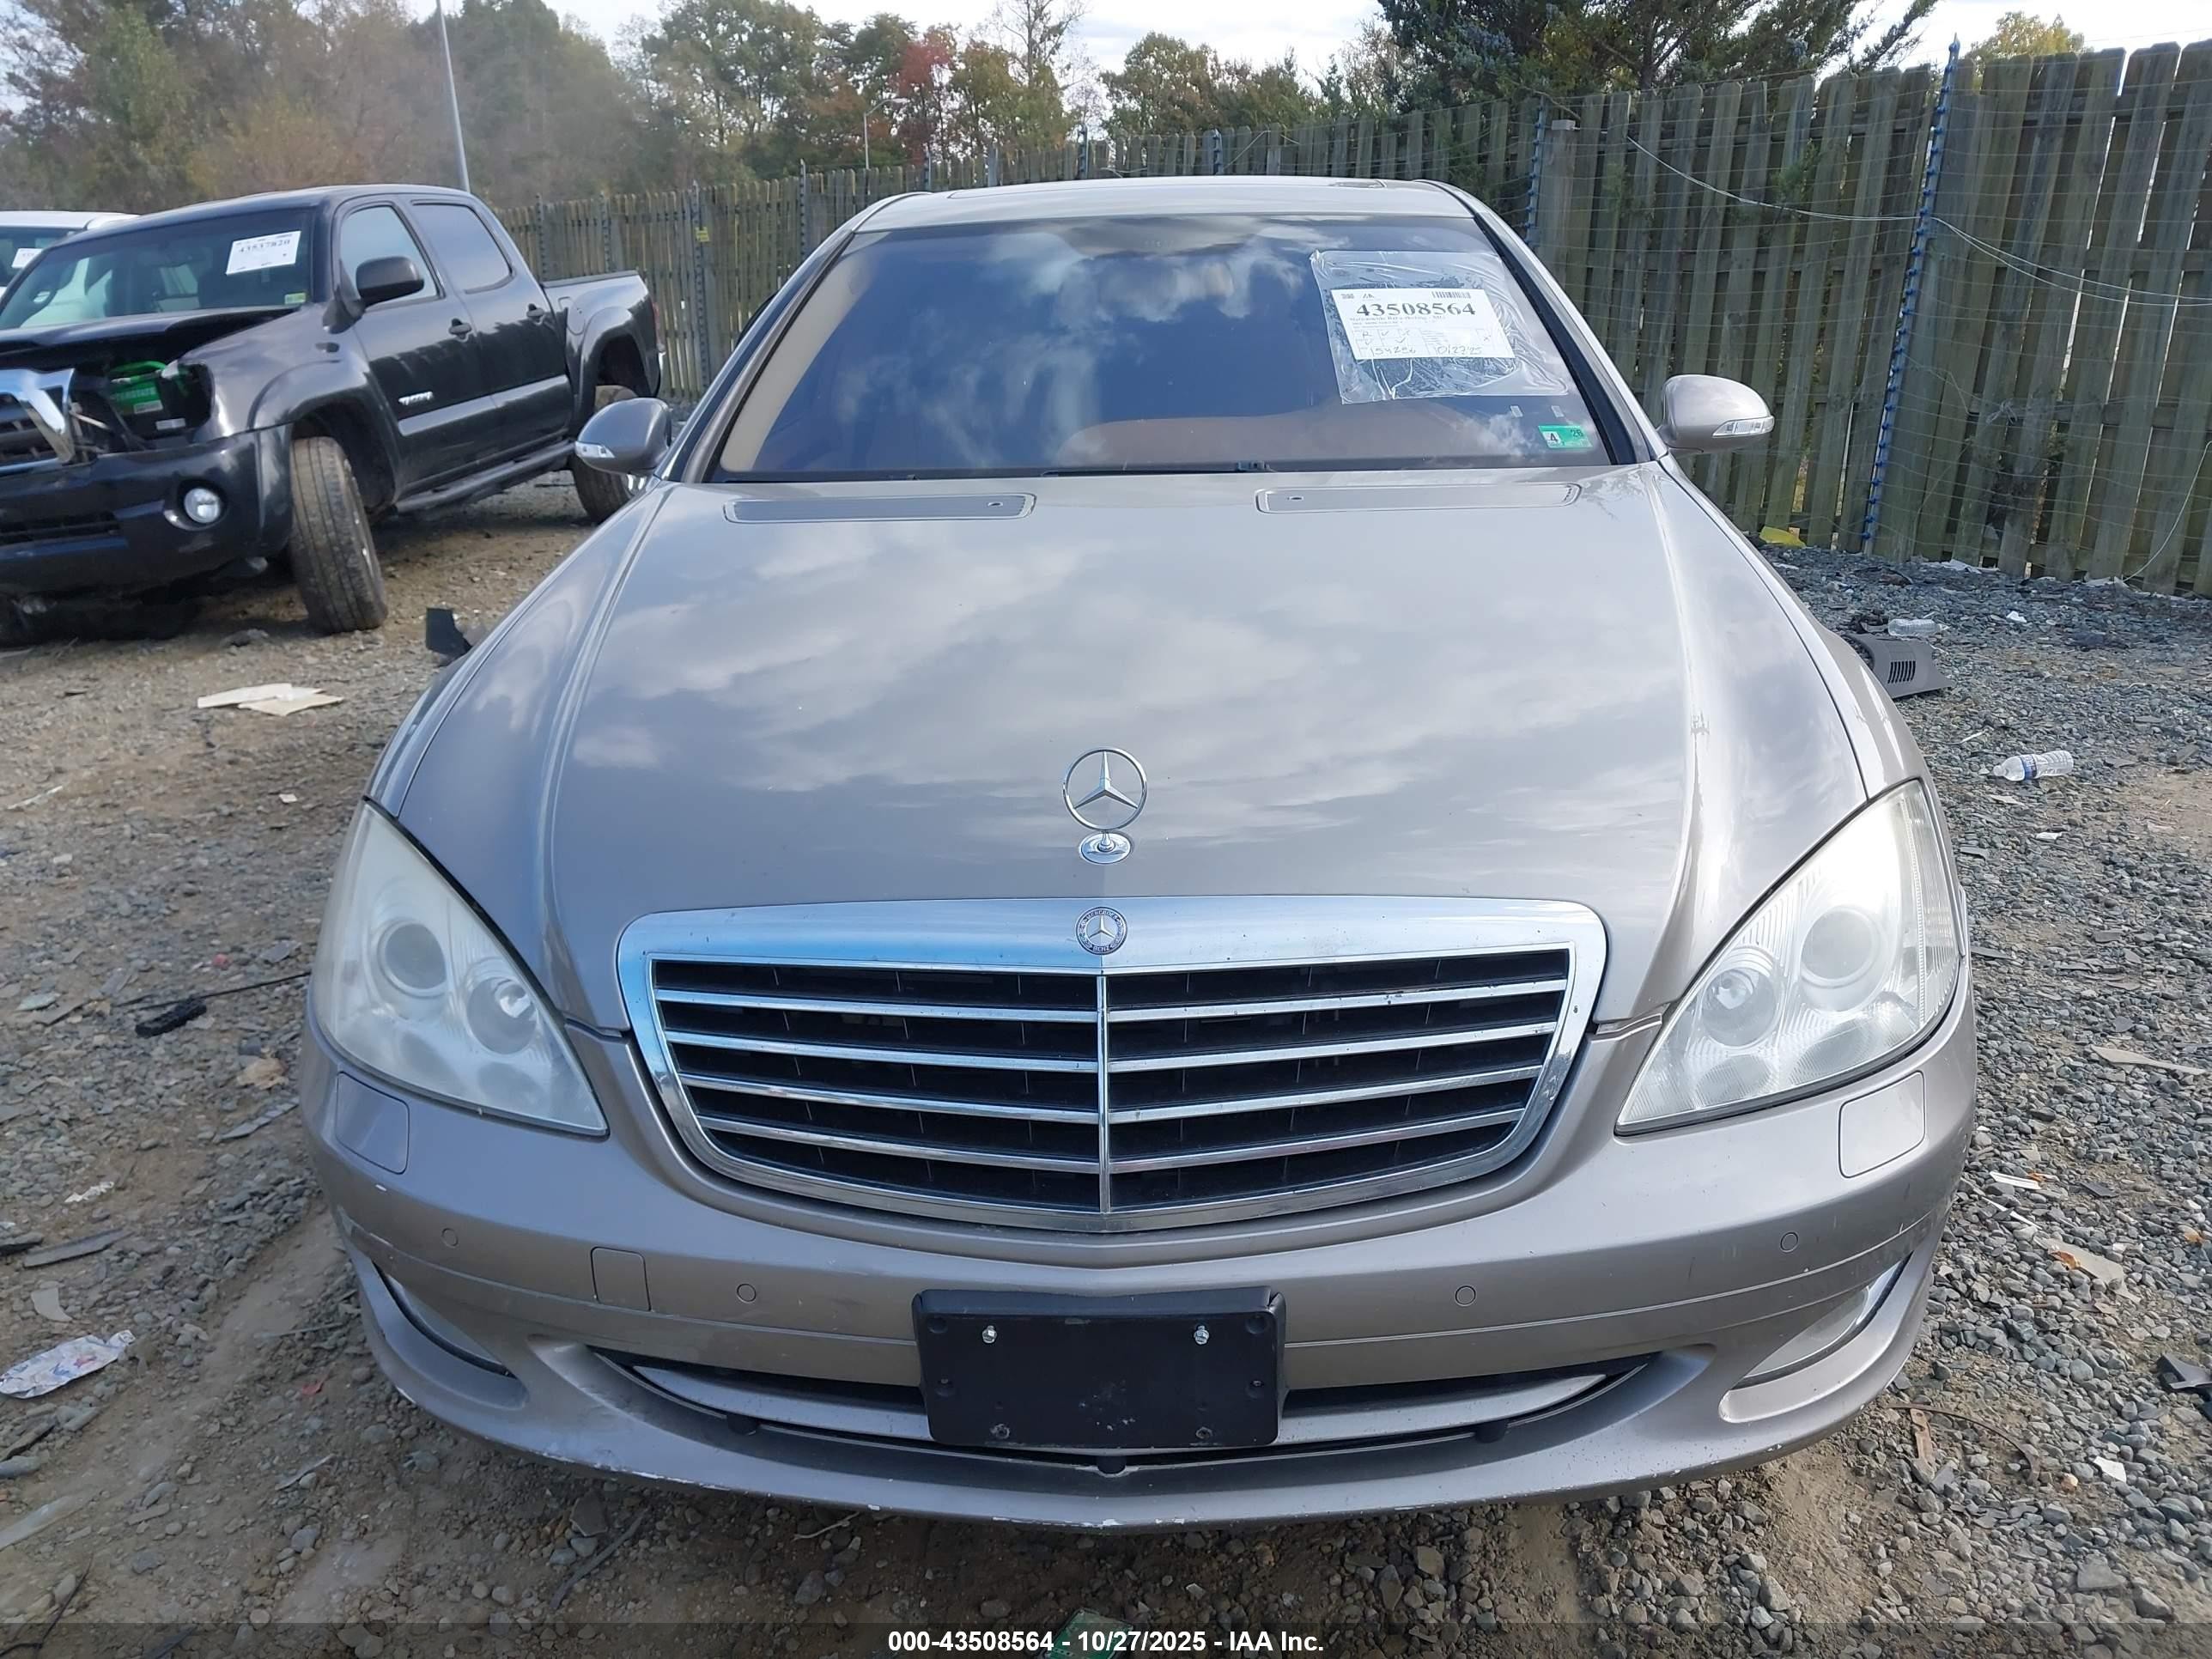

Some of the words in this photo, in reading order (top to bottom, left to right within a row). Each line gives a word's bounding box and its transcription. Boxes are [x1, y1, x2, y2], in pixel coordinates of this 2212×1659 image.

[1356, 302, 1476, 316] 43508564
[1550, 433, 1559, 442] 4
[1085, 909, 1118, 921] MERCEDES
